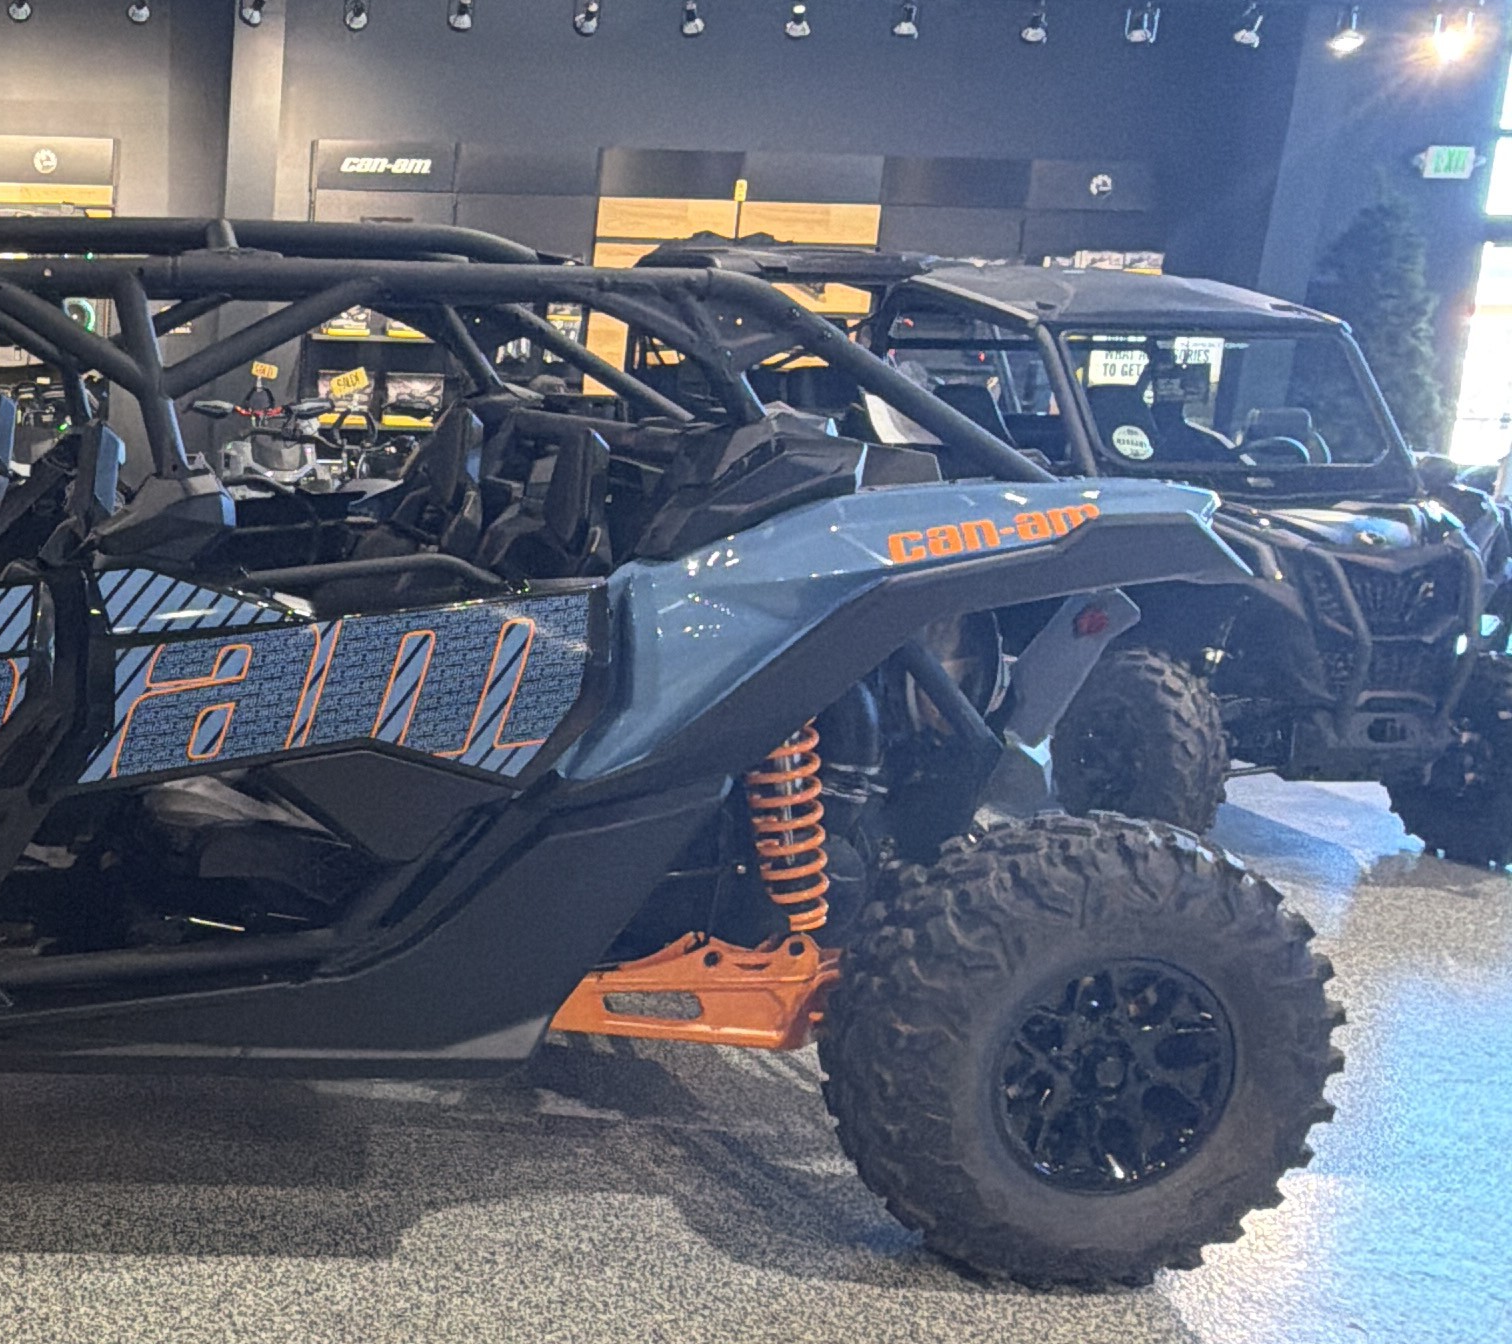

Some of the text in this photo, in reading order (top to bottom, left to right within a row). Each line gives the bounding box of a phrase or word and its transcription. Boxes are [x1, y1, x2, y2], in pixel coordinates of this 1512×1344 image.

[340, 156, 432, 174] can-am
[1102, 363, 1116, 377] TO
[887, 503, 1101, 565] can-am
